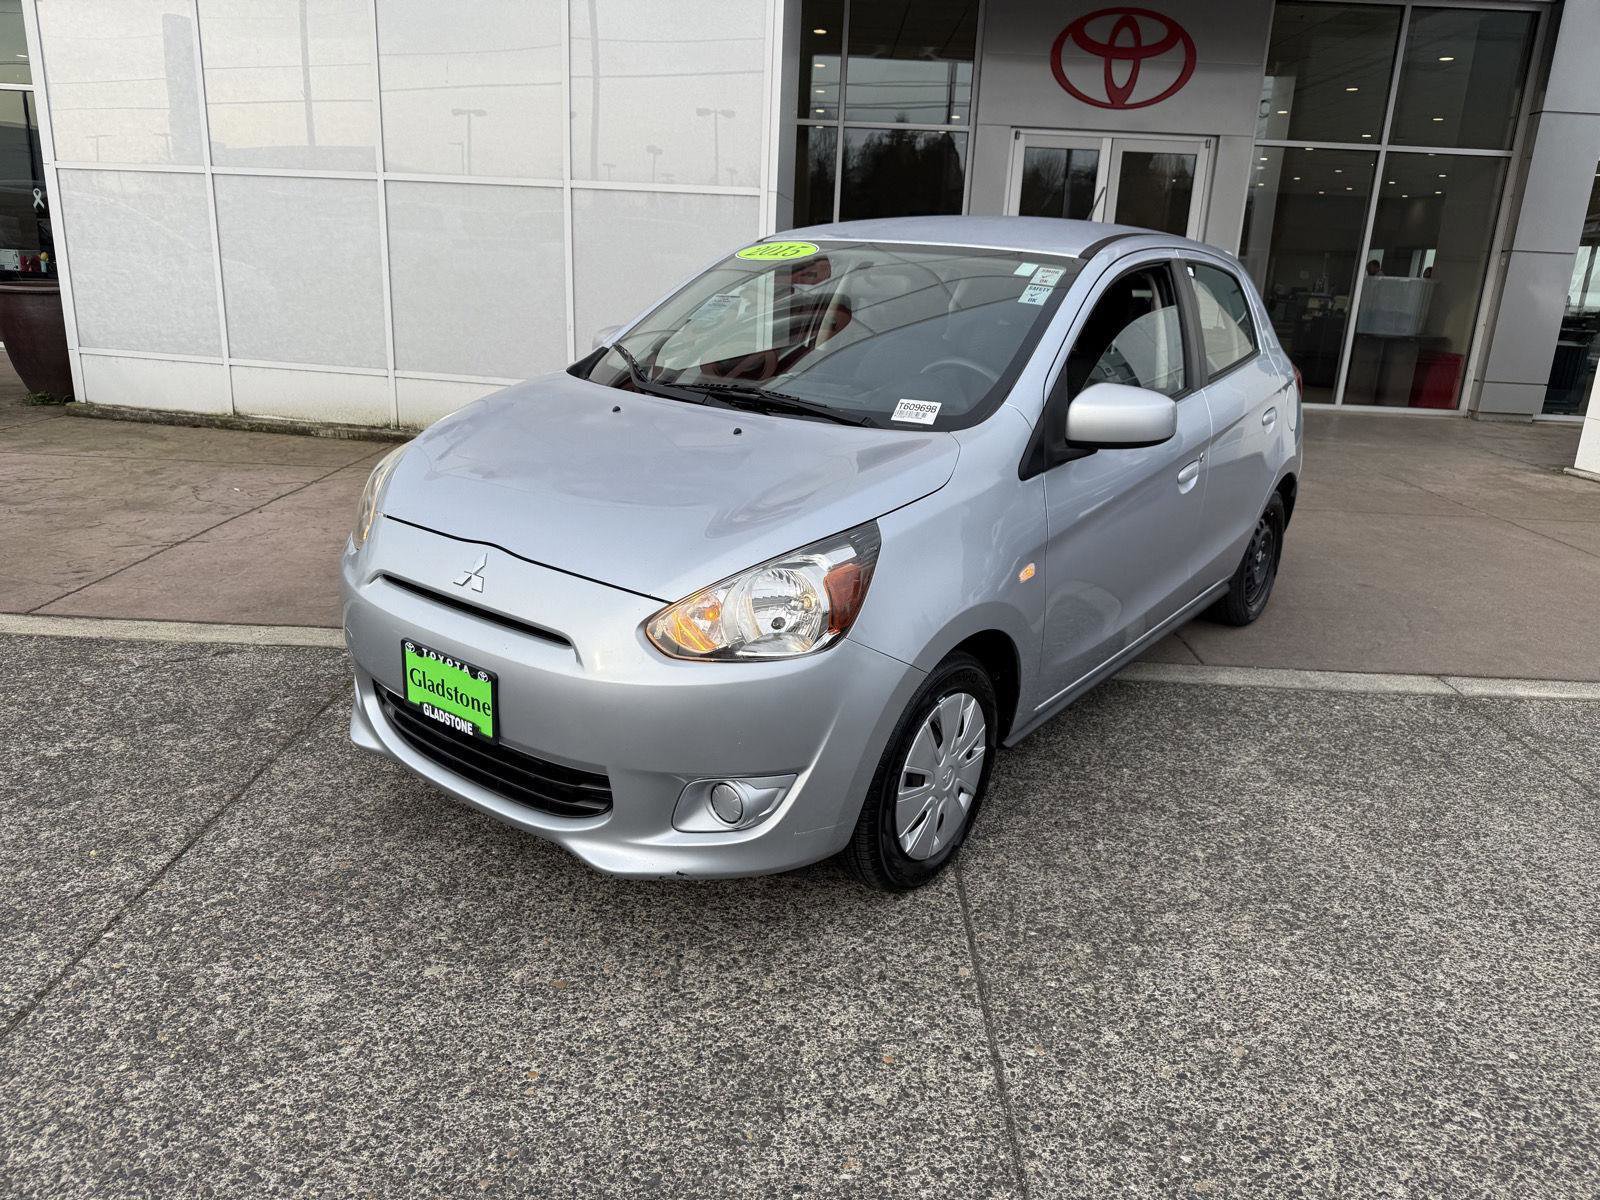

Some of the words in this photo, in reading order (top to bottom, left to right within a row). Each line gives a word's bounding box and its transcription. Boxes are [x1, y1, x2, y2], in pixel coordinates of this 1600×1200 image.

[744, 245, 809, 257] 2015
[422, 647, 470, 675] TOYOTA
[409, 667, 492, 717] Gladstone
[423, 703, 474, 736] GLADSTONE
